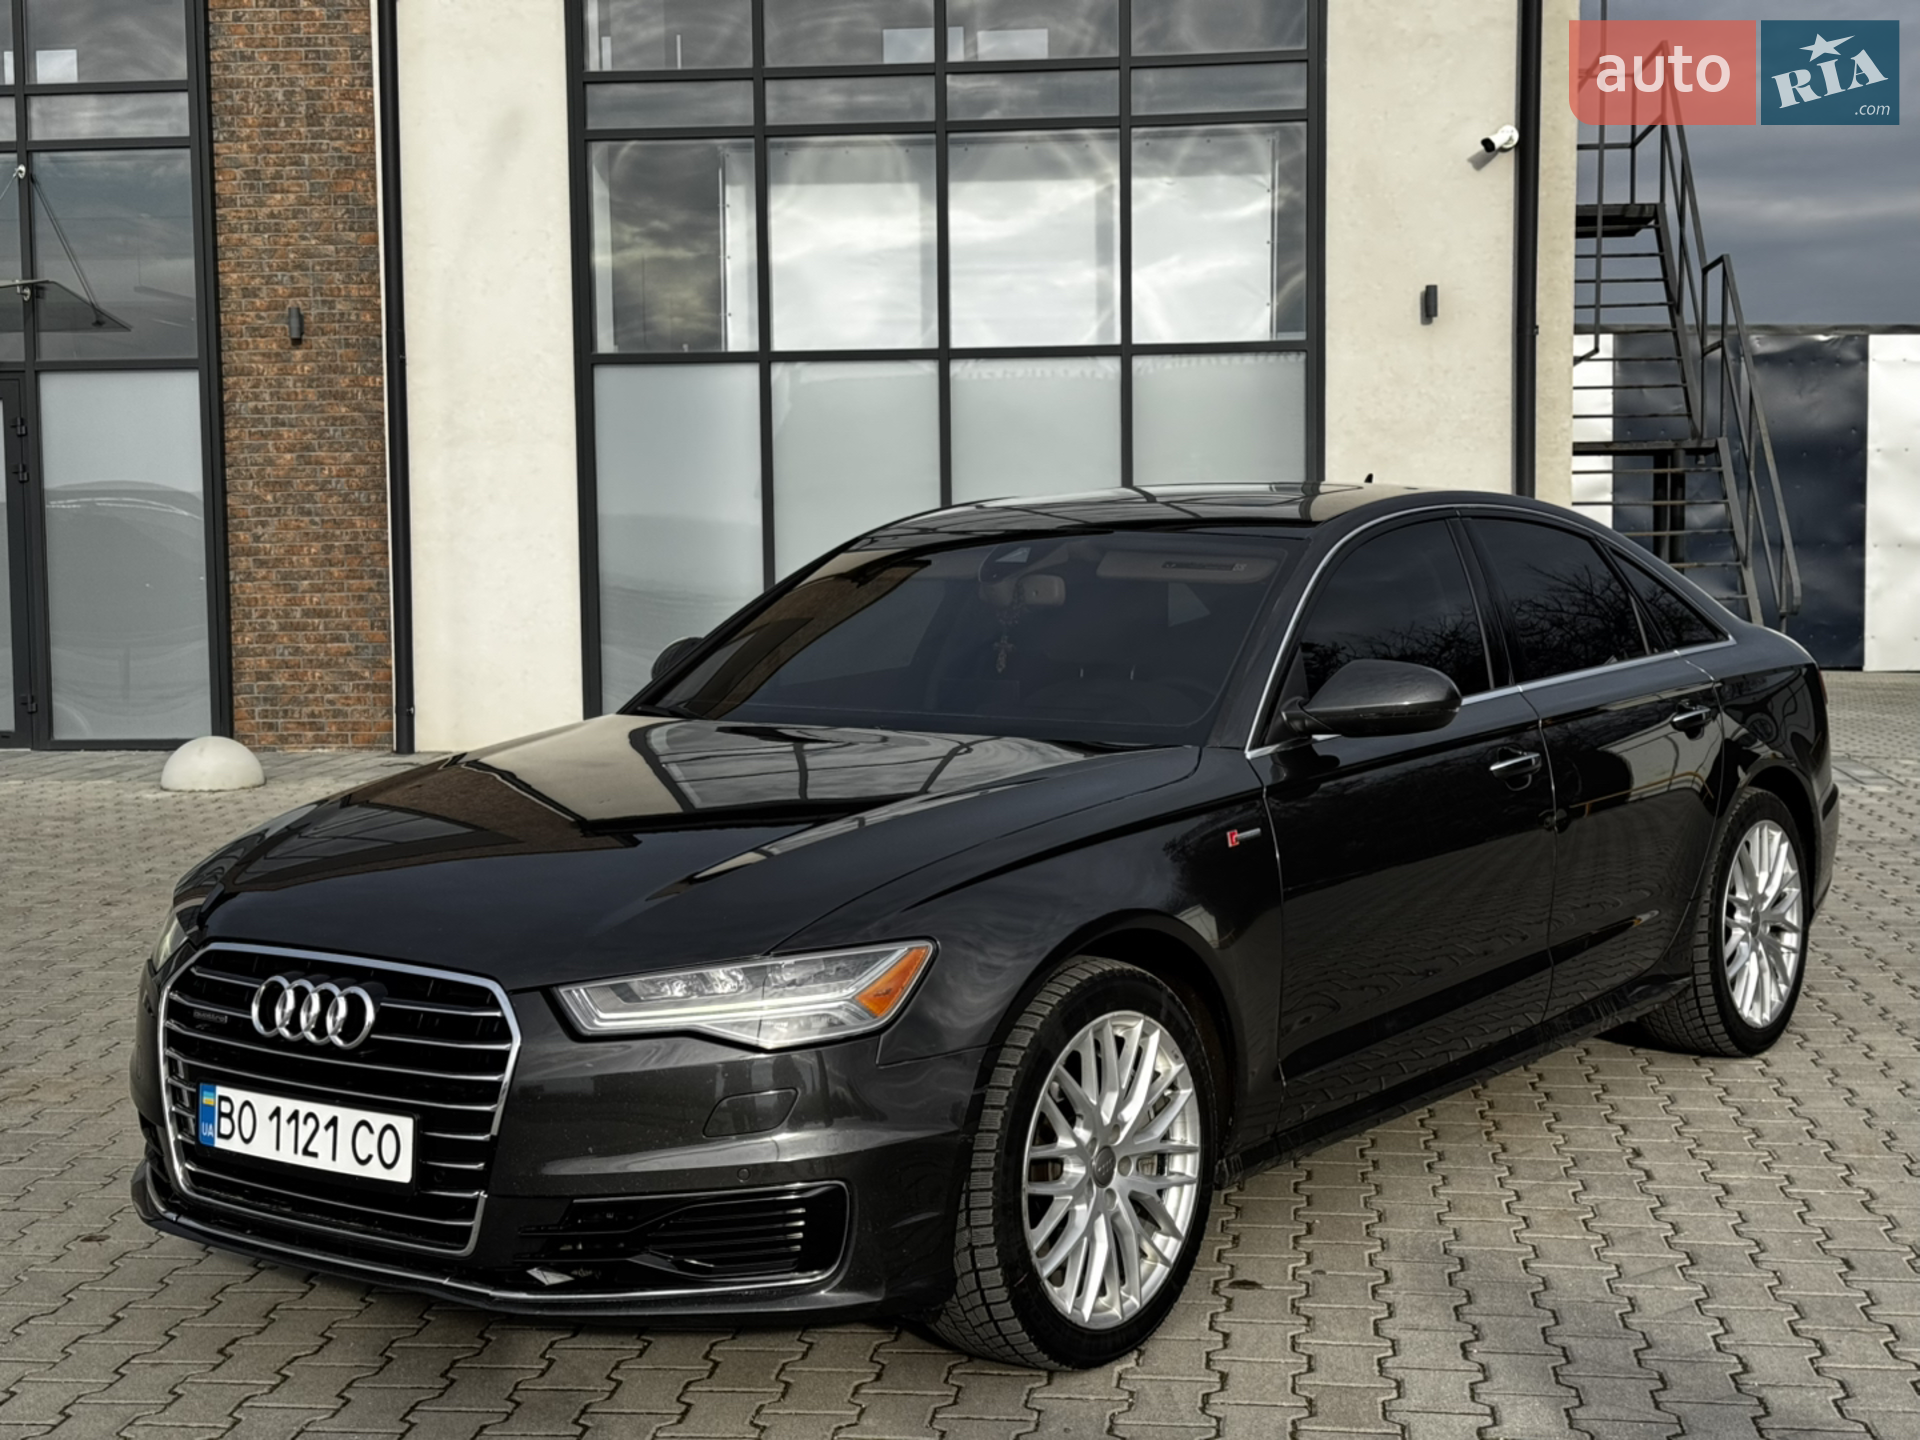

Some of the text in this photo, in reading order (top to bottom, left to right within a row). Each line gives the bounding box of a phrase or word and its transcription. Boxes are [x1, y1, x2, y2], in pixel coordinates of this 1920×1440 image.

[202, 1122, 214, 1137] UA
[217, 1094, 401, 1170] BO 1121 CO
